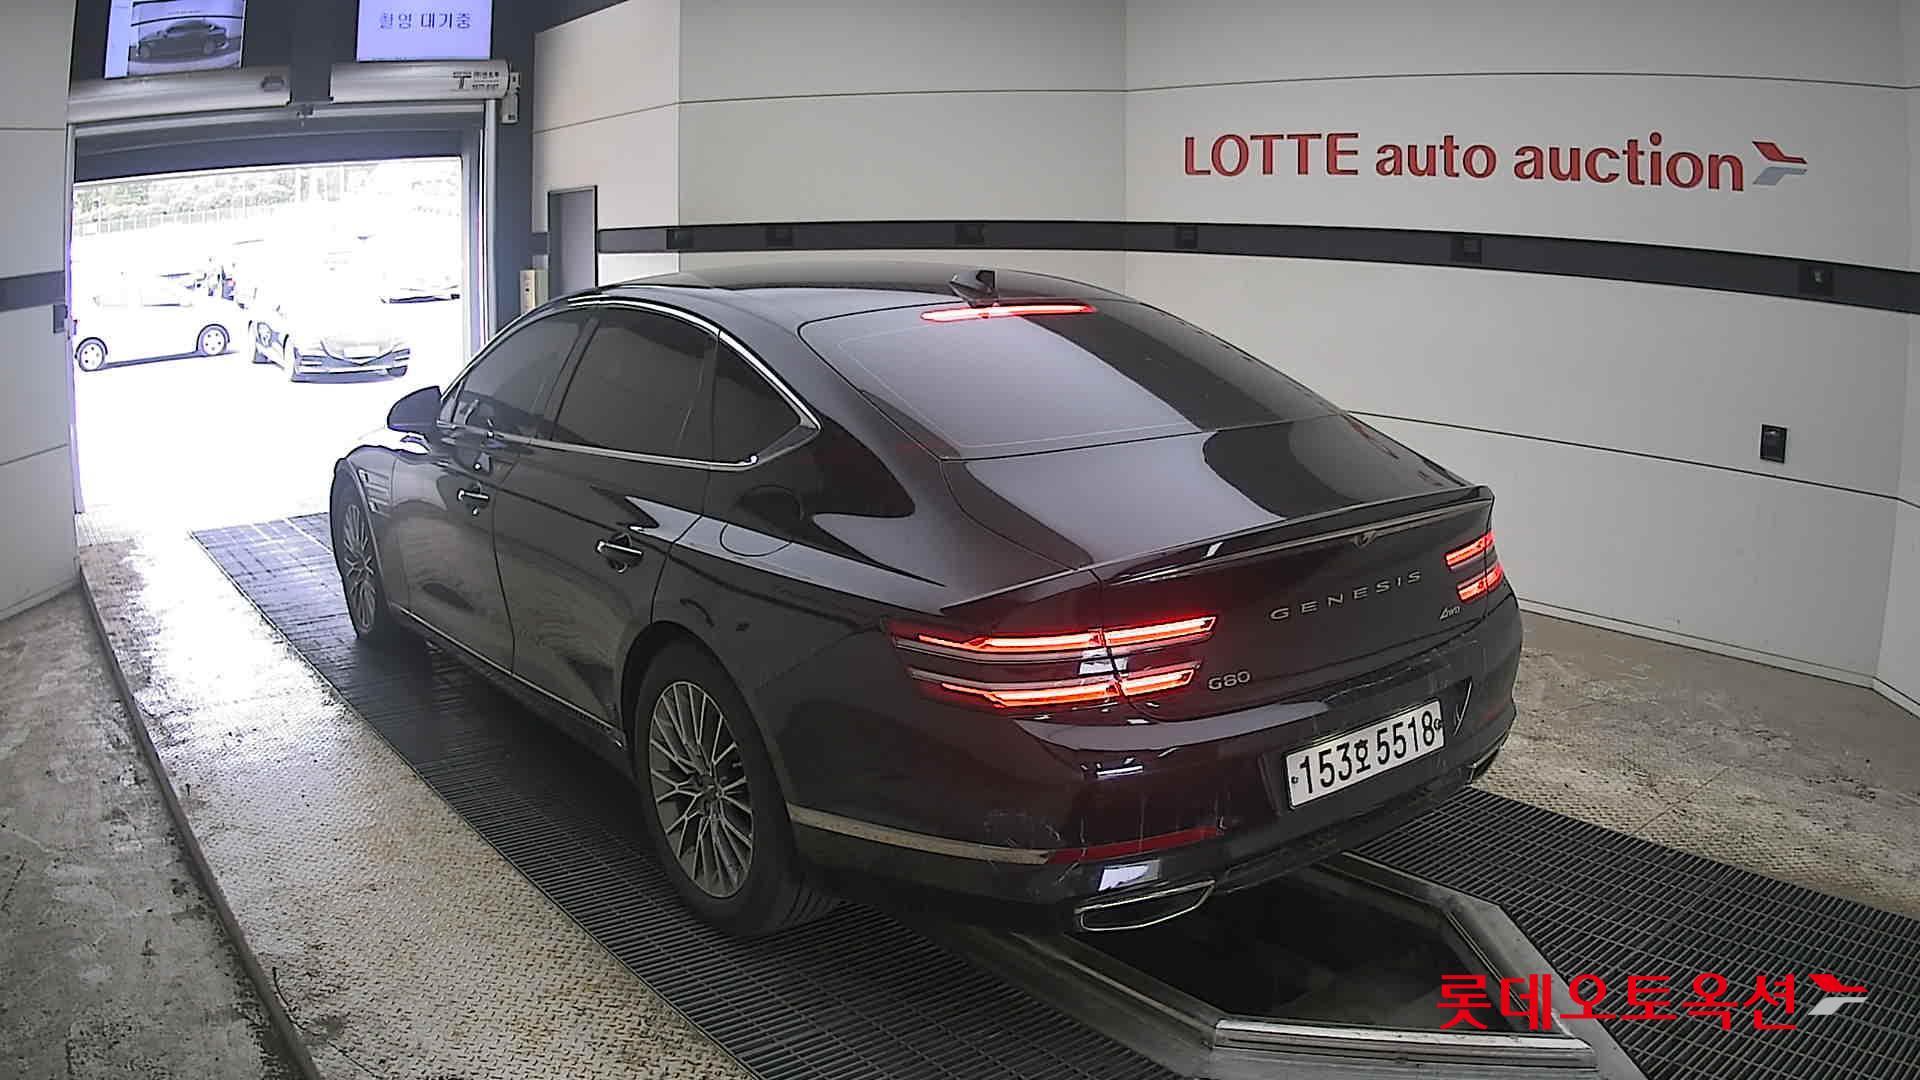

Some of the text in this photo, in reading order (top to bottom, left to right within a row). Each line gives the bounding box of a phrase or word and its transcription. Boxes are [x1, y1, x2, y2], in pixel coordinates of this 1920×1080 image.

[420, 11, 471, 29] 대기중
[1184, 131, 1743, 192] LOTTE auto auction
[1269, 569, 1422, 620] GENESIS
[1208, 671, 1250, 690] G80
[1376, 710, 1435, 765] 5518
